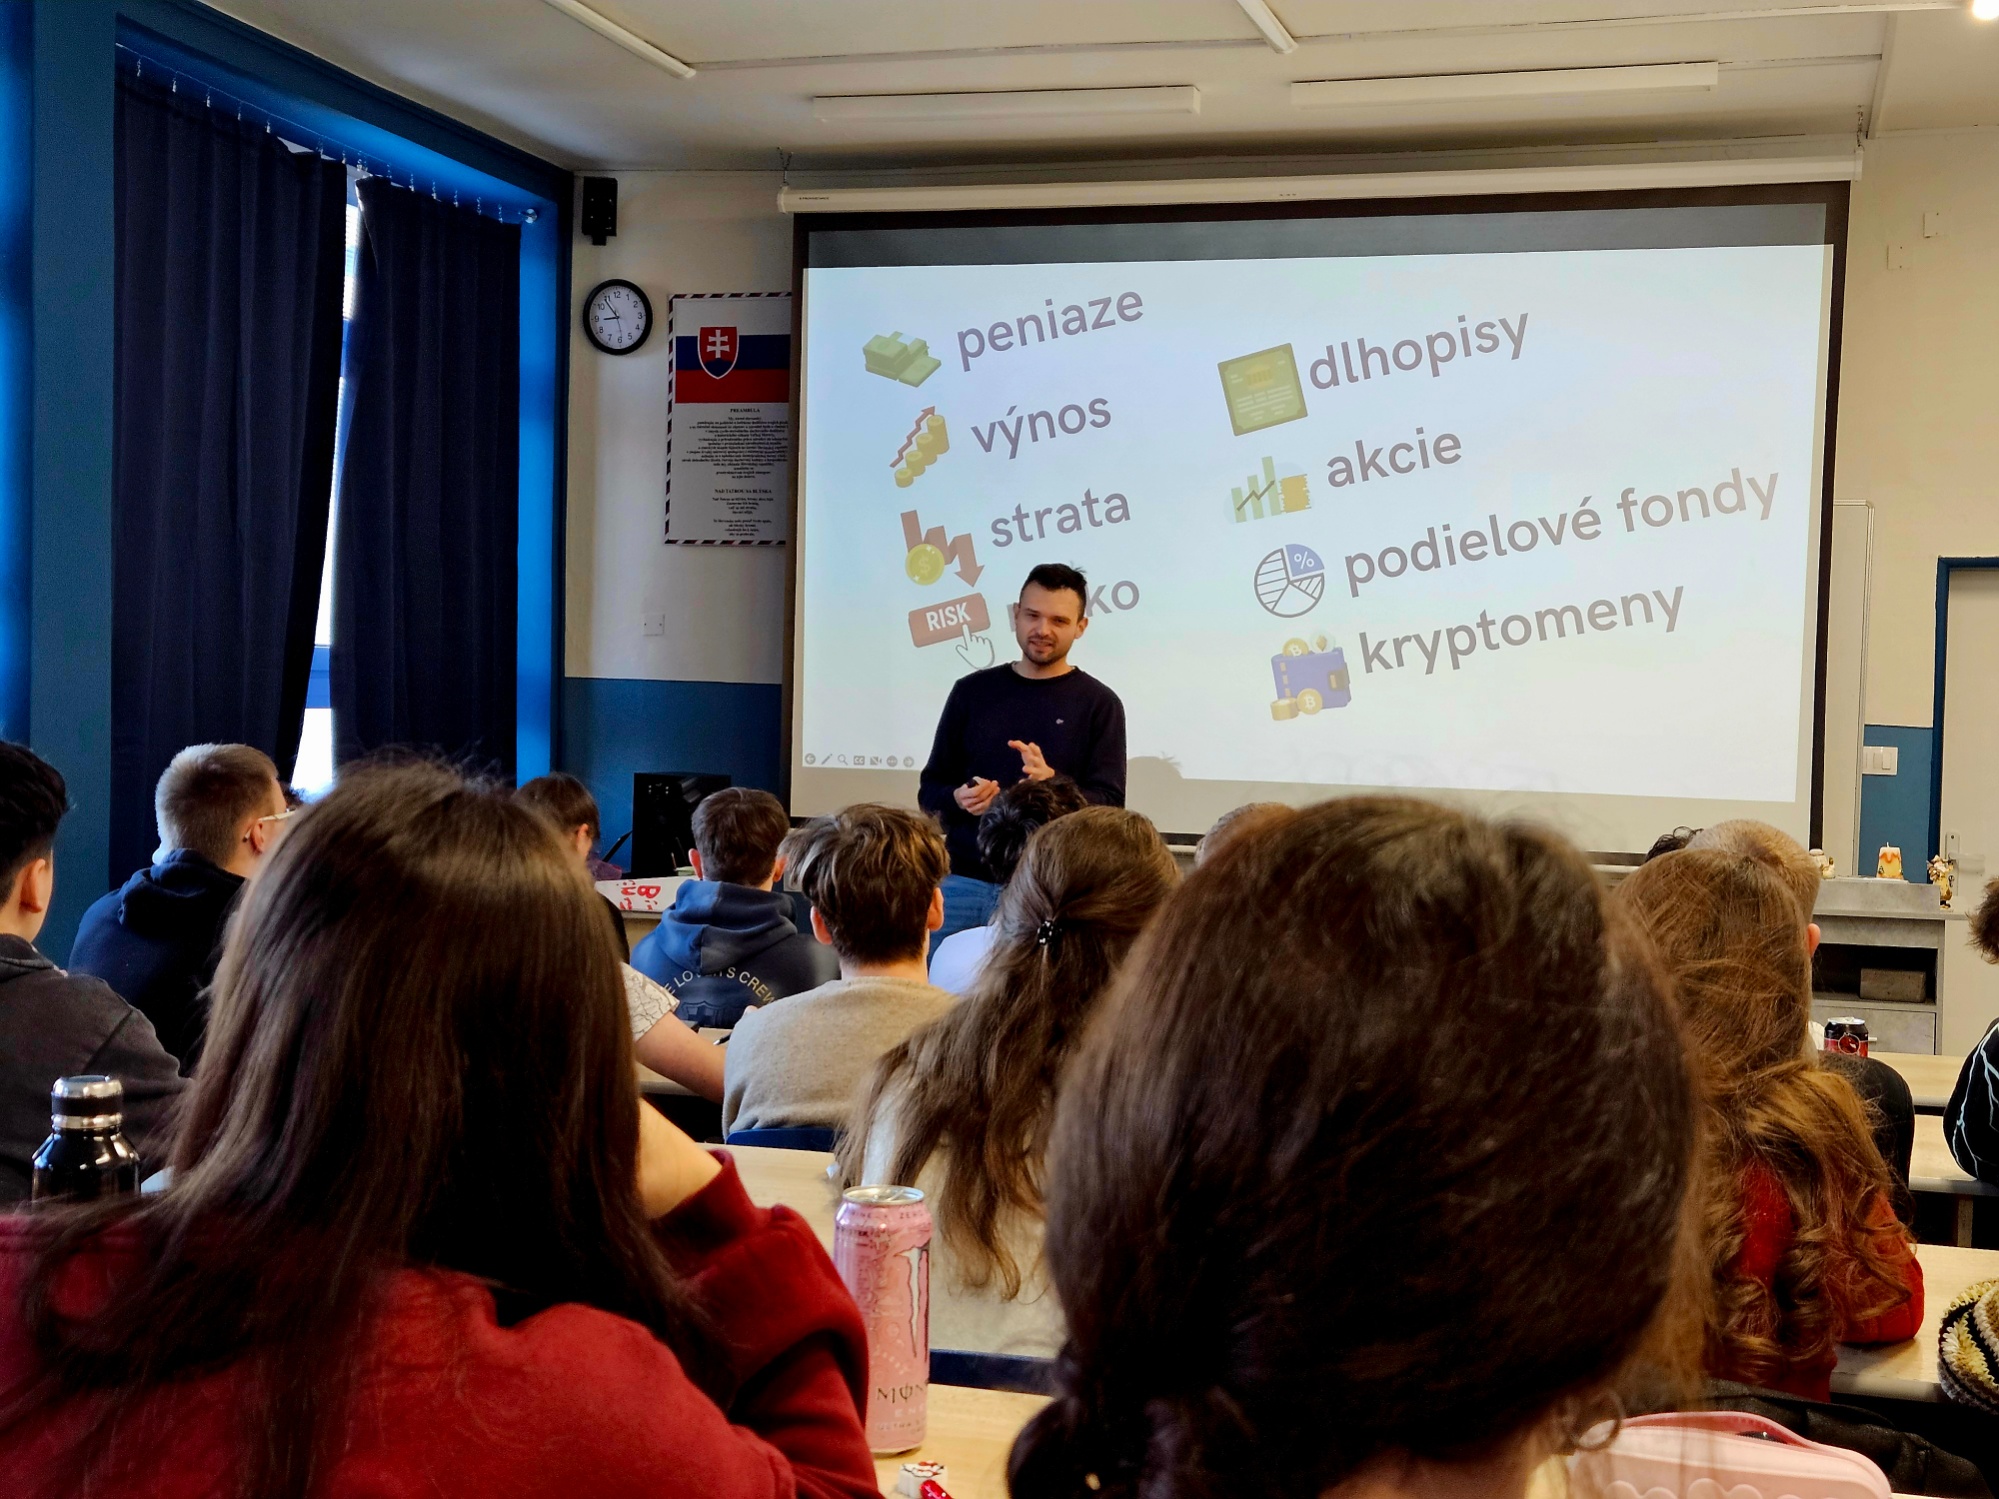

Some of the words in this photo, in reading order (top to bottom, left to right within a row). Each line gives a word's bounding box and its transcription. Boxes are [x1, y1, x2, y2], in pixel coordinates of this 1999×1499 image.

[597, 302, 605, 310] 10
[613, 291, 621, 299] 12
[957, 290, 1144, 372] peniaze
[1309, 312, 1529, 391] dlhopisy
[971, 397, 1112, 460] výnos
[1326, 426, 1463, 488] akcie
[990, 488, 1131, 548] strata
[1344, 495, 1602, 598] podielové
[1617, 467, 1779, 533] fondy
[1294, 551, 1315, 569] %
[925, 601, 971, 632] RISK
[1359, 585, 1684, 675] kryptomeny
